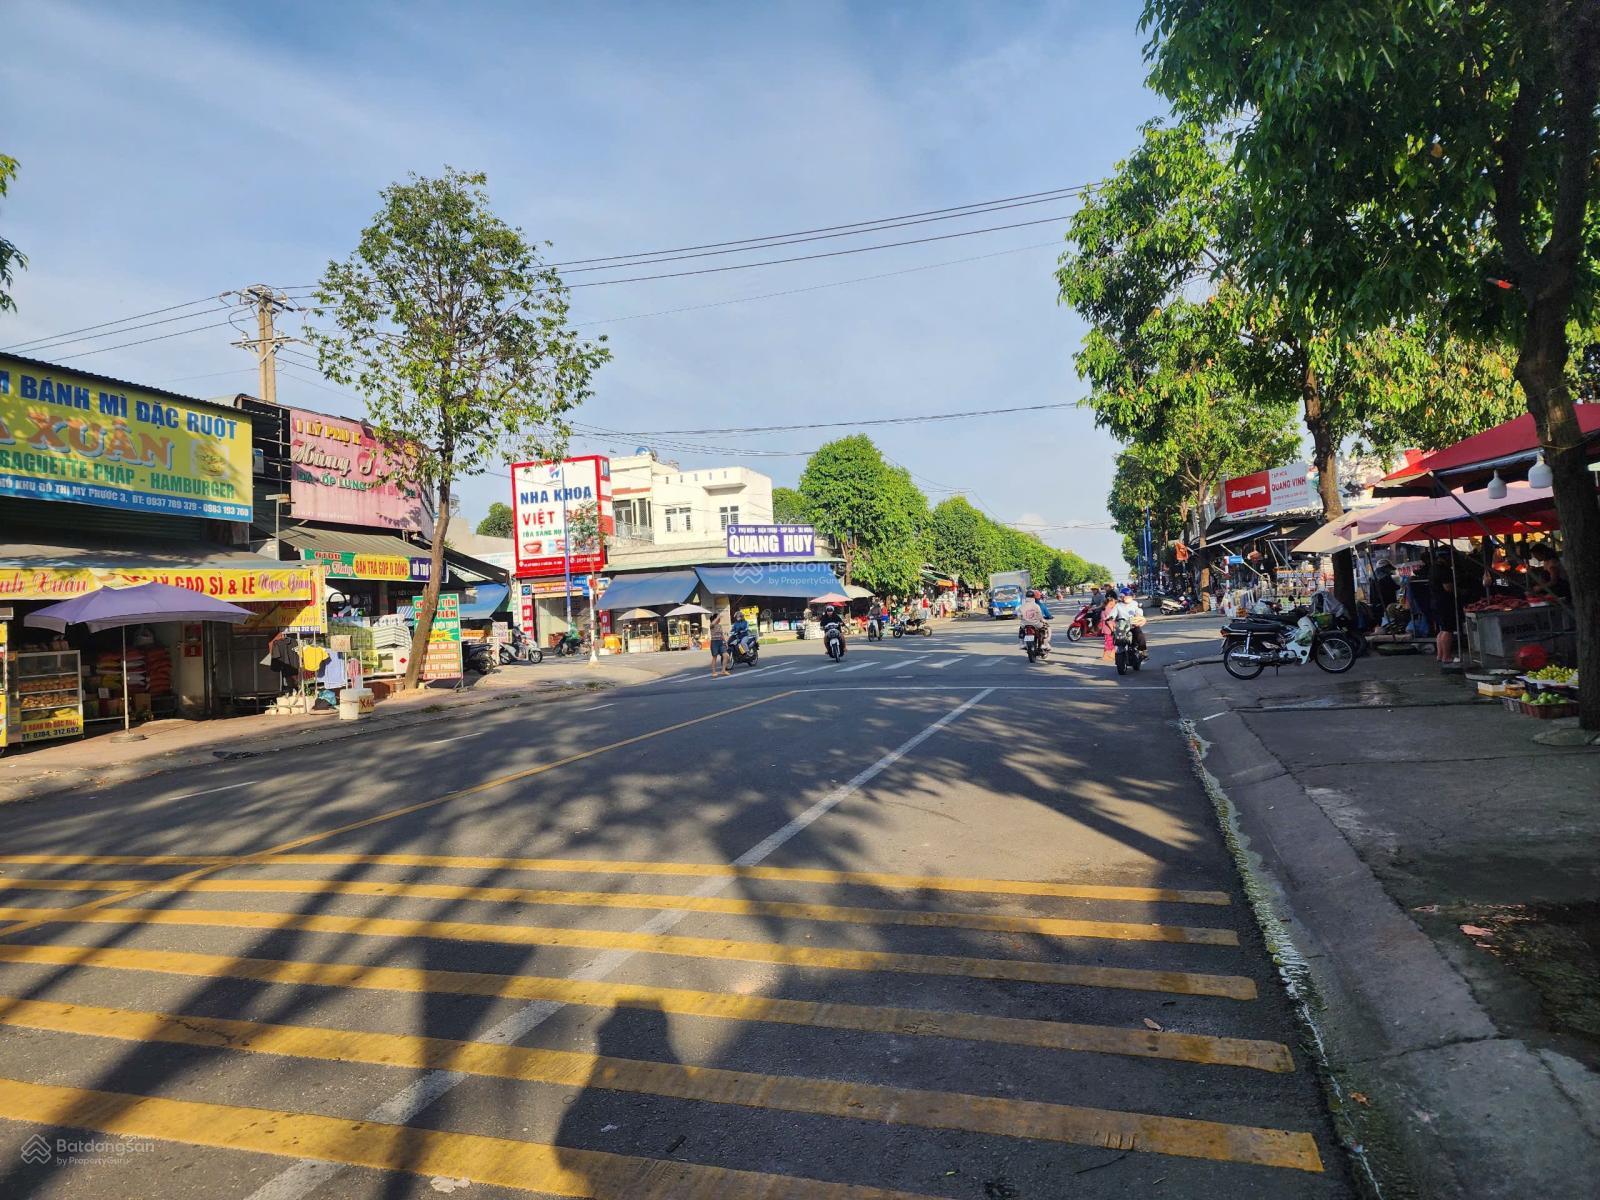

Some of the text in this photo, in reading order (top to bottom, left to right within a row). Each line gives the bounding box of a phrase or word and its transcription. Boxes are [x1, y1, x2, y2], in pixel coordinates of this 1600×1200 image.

[20, 375, 91, 411] BÁNH
[99, 392, 128, 418] MÌ
[135, 400, 180, 430] ĐẶC
[186, 413, 238, 441] RUỘT
[27, 409, 174, 471] XUÂN
[93, 461, 136, 486] PHÁP
[150, 472, 236, 499] HAMBURGER
[1271, 475, 1307, 492] QUANG VINH
[520, 485, 593, 505] NHA KHOA
[522, 509, 555, 529] VIỆT
[729, 534, 813, 555] QUANG HUY
[228, 579, 237, 594] &
